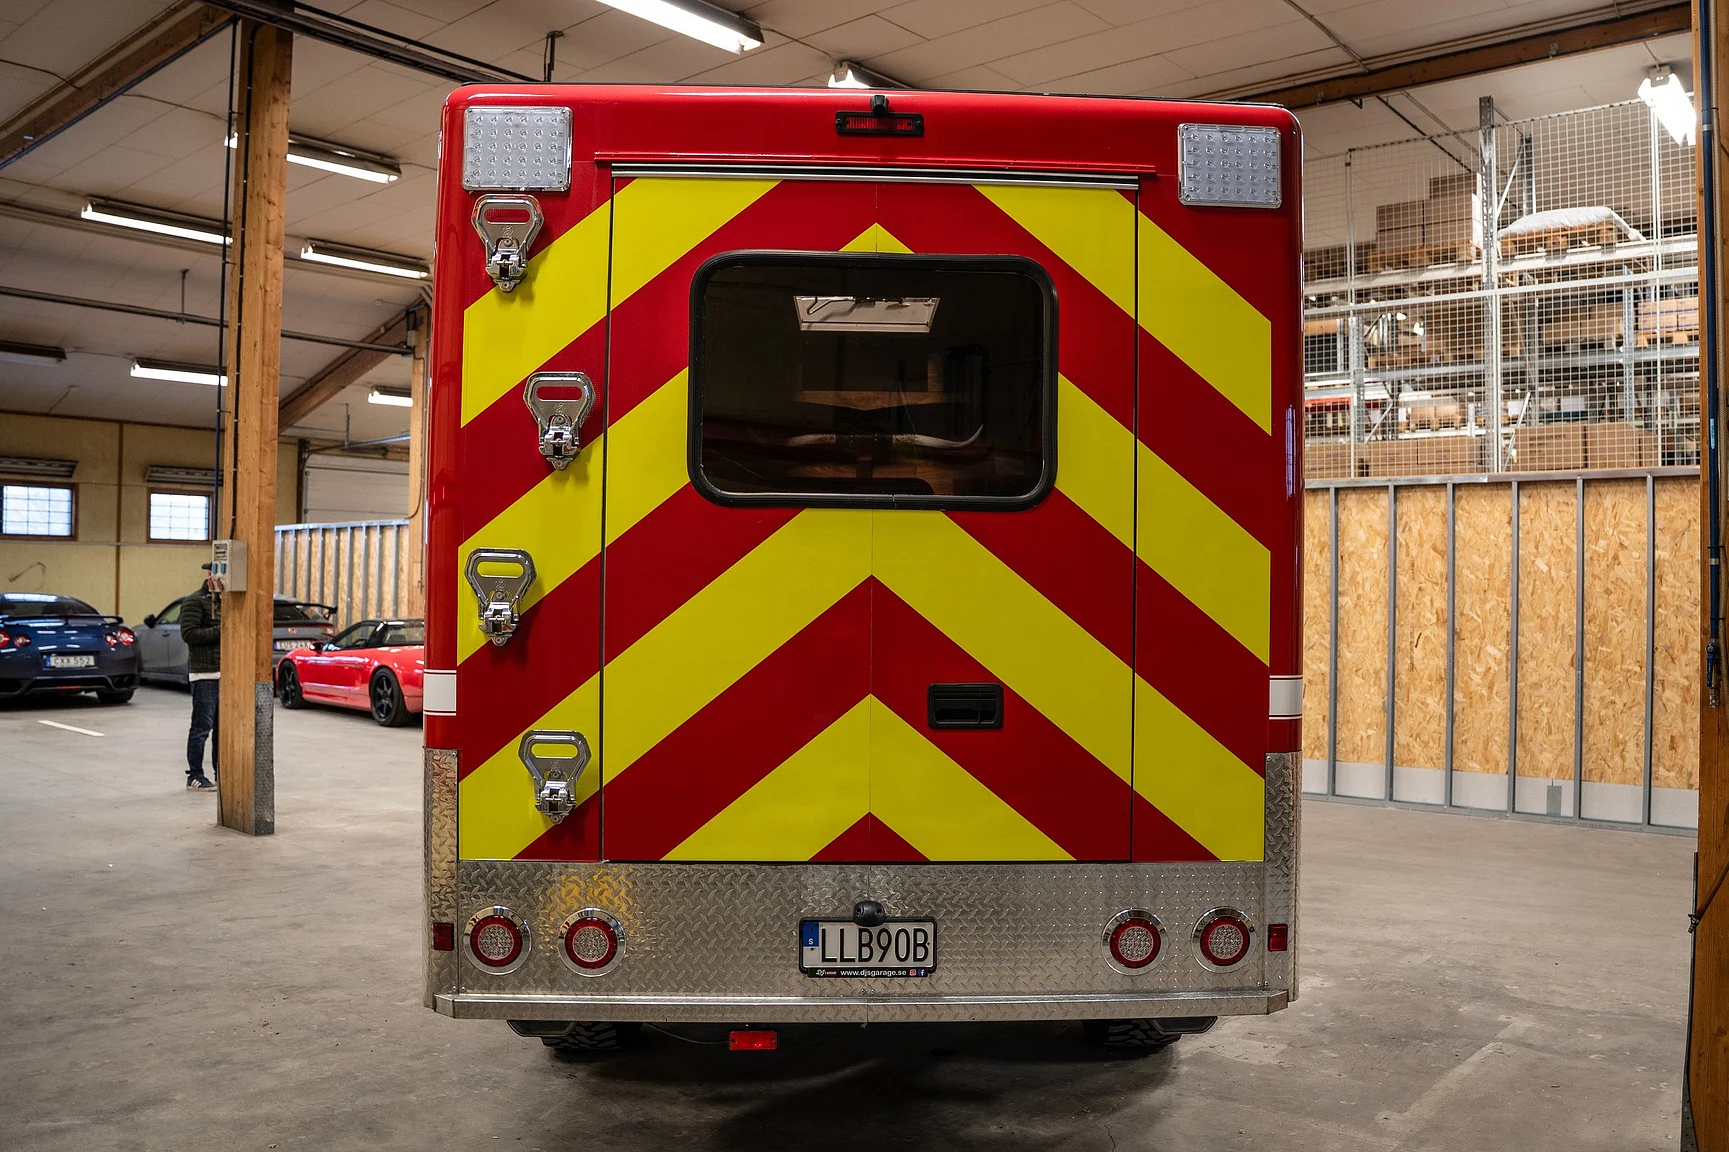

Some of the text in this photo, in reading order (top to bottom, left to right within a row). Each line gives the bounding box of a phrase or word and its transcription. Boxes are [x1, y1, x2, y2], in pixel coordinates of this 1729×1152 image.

[73, 656, 91, 665] 552
[821, 928, 928, 963] LLB90B
[840, 969, 907, 977] www.djsgarage.se
